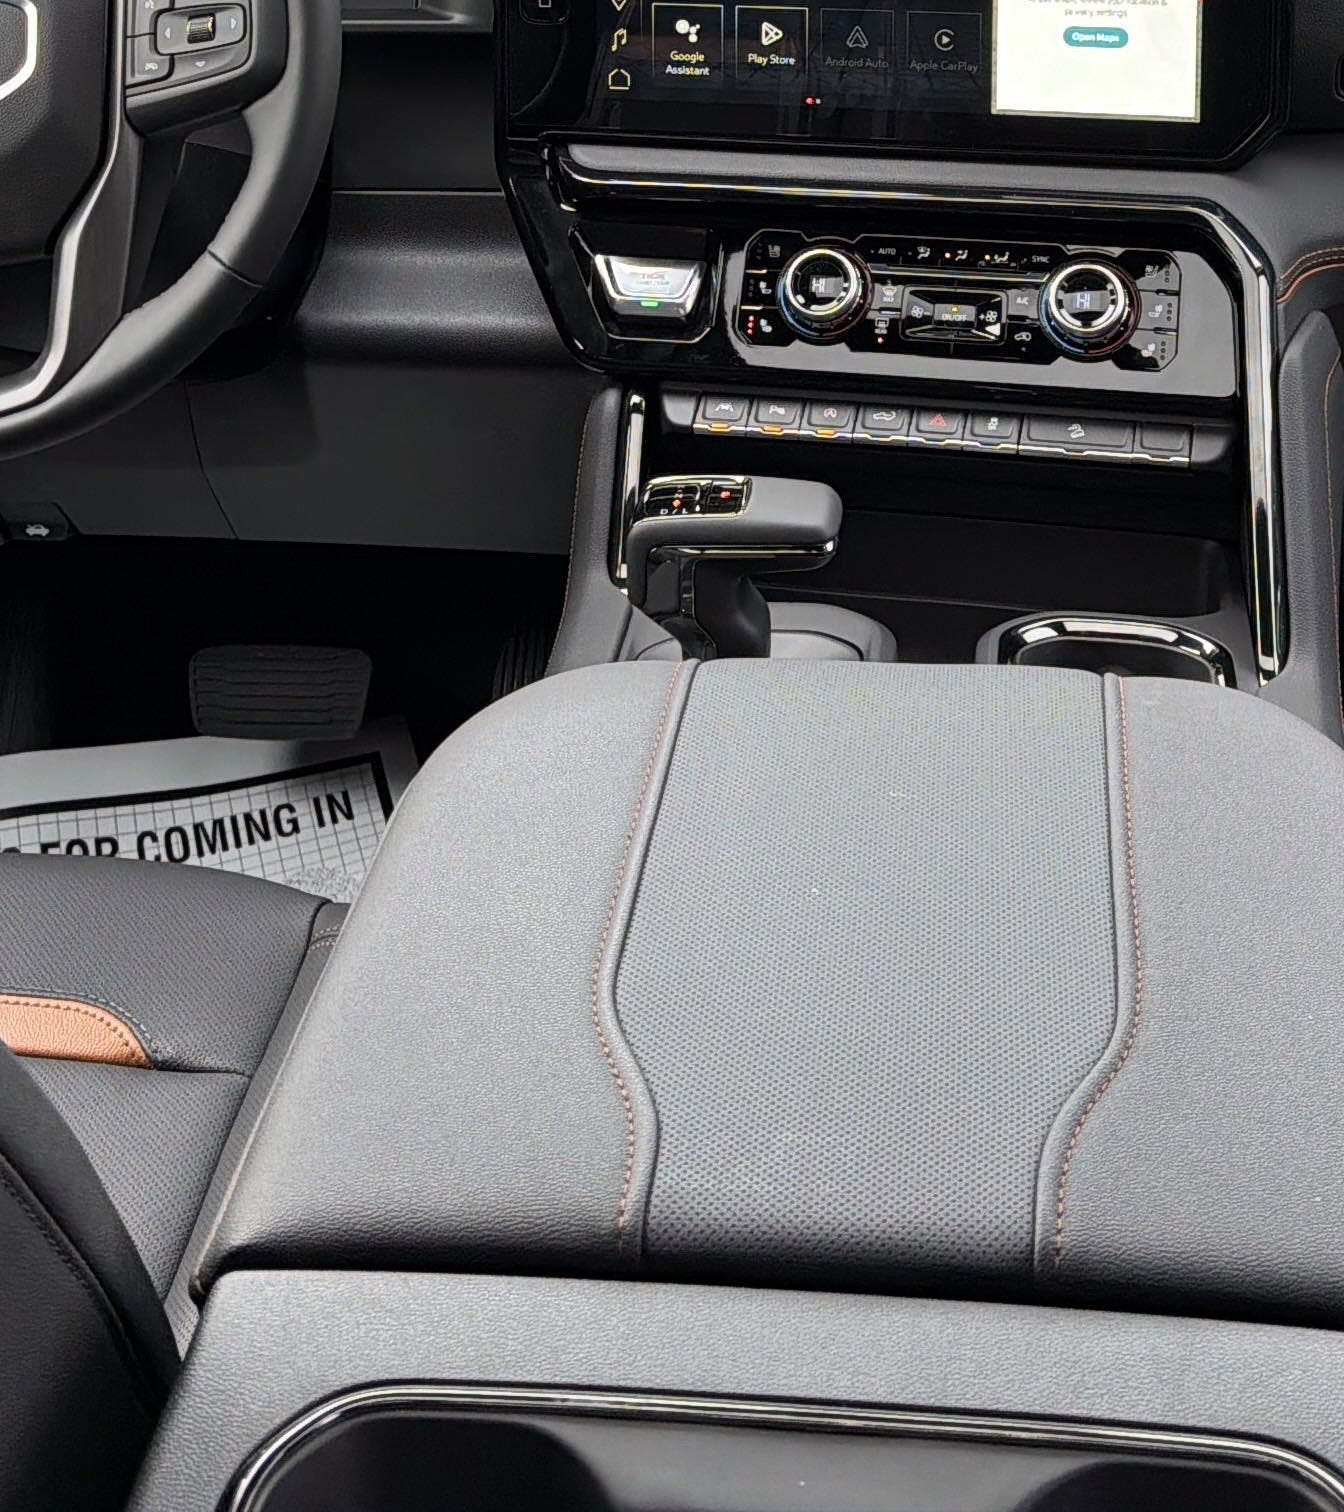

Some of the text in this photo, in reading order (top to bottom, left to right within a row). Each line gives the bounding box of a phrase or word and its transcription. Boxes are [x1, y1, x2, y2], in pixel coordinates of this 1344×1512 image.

[1071, 32, 1120, 44] Open Maps
[670, 51, 704, 64] Google
[748, 53, 795, 66] Play Store
[825, 56, 888, 68] Android Auto
[665, 65, 709, 76] Assistant
[910, 59, 978, 72] Apple CarPlay
[1032, 256, 1050, 264] SYNC
[1016, 296, 1029, 305] A/C
[942, 313, 967, 322] ON/OFF
[136, 790, 356, 866] COMING IN
